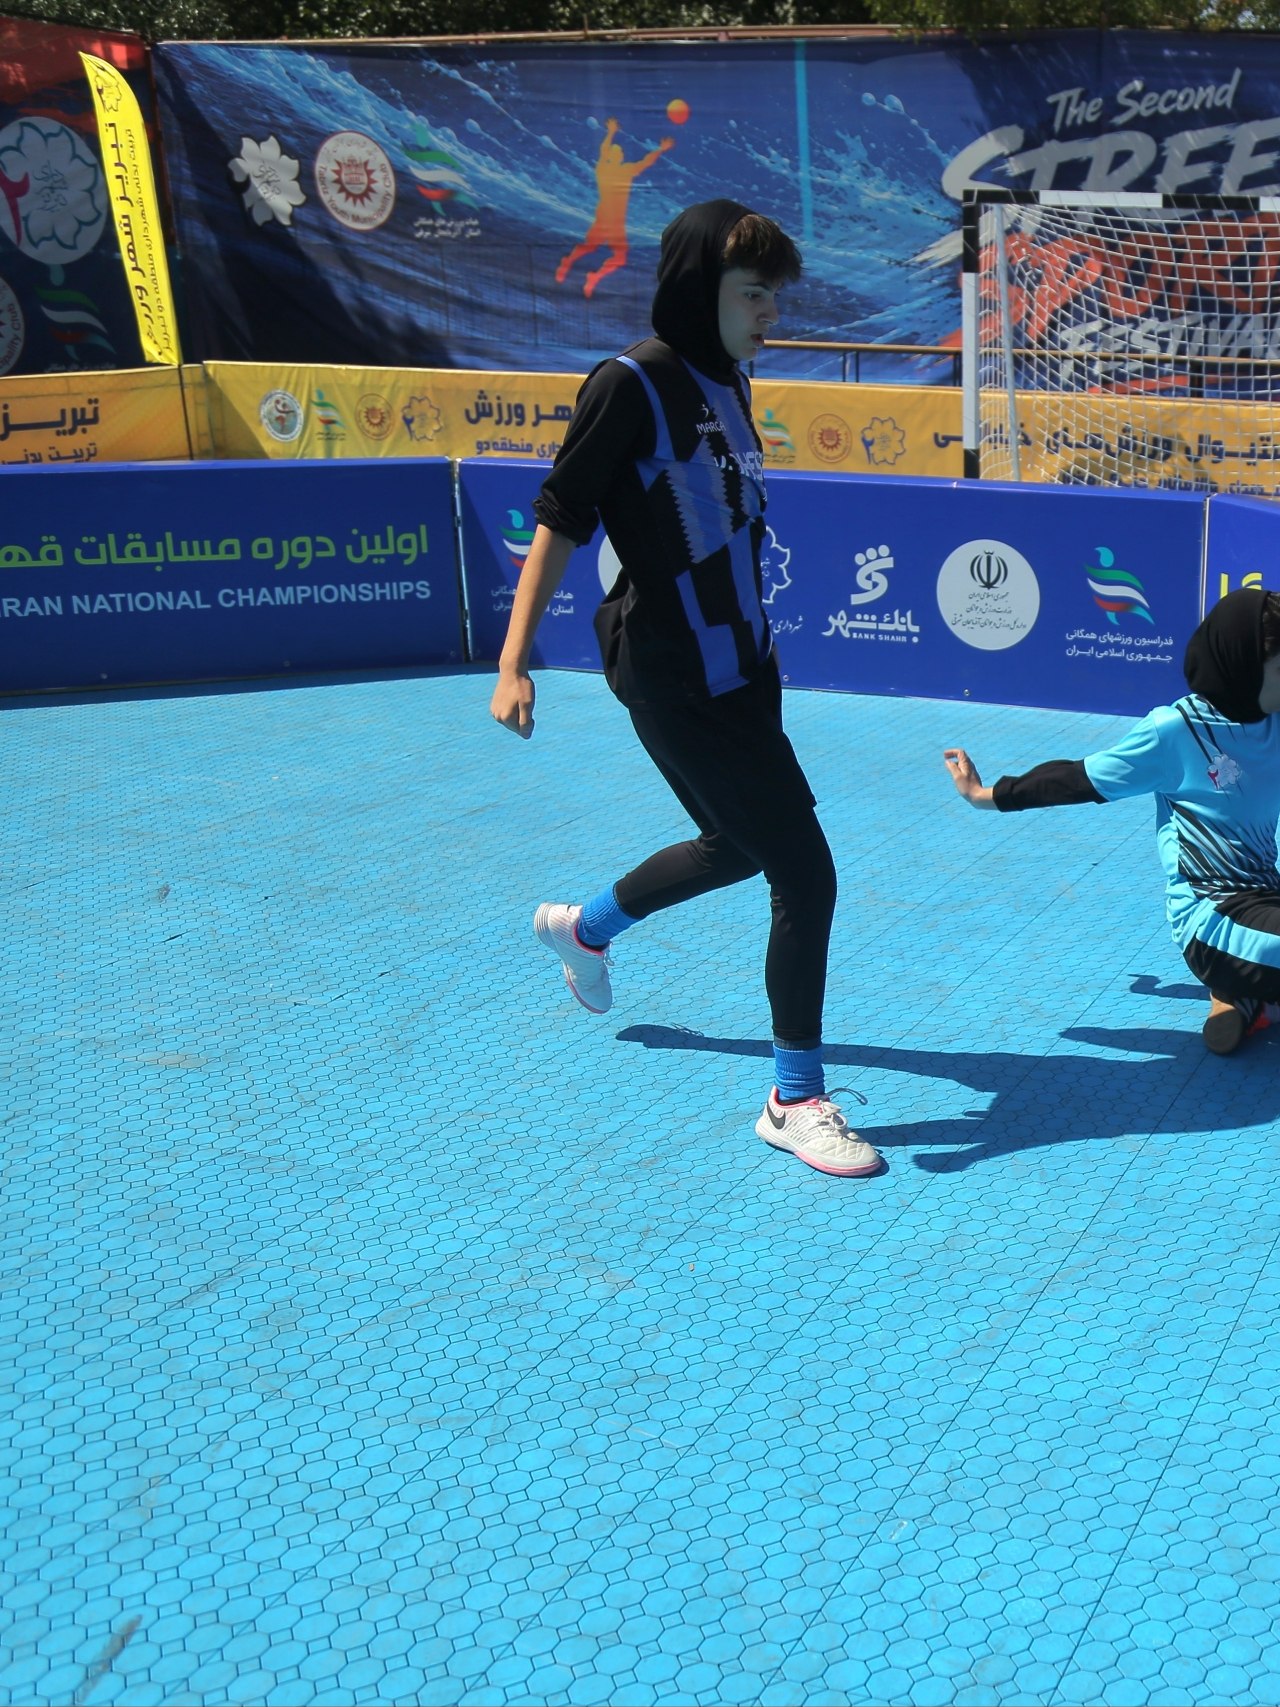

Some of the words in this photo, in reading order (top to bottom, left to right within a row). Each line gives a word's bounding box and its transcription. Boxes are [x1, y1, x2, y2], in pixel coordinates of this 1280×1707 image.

[1047, 86, 1104, 132] The
[1110, 67, 1243, 126] Second
[105, 122, 135, 207] تبریز
[118, 213, 147, 279] شهر
[0, 398, 99, 441] تبریز
[464, 389, 526, 426] ورزش
[531, 404, 577, 428] هر
[696, 421, 727, 434] MARCA
[475, 440, 491, 455] دو
[491, 436, 534, 453] منطقه
[74, 531, 242, 572] مسابقات
[251, 535, 336, 570] دوره
[345, 524, 429, 566] اولین
[72, 589, 211, 614] NATIONAL
[218, 580, 431, 609] CHAMPIONSHIPS
[852, 632, 876, 641] BANK
[878, 633, 908, 643] SHAHR
[1065, 628, 1098, 640] همگانی
[1134, 636, 1174, 647] فدراسیون
[1066, 645, 1094, 656] ایران
[1095, 648, 1125, 658] اسلامی
[1126, 651, 1173, 663] جمهوری
